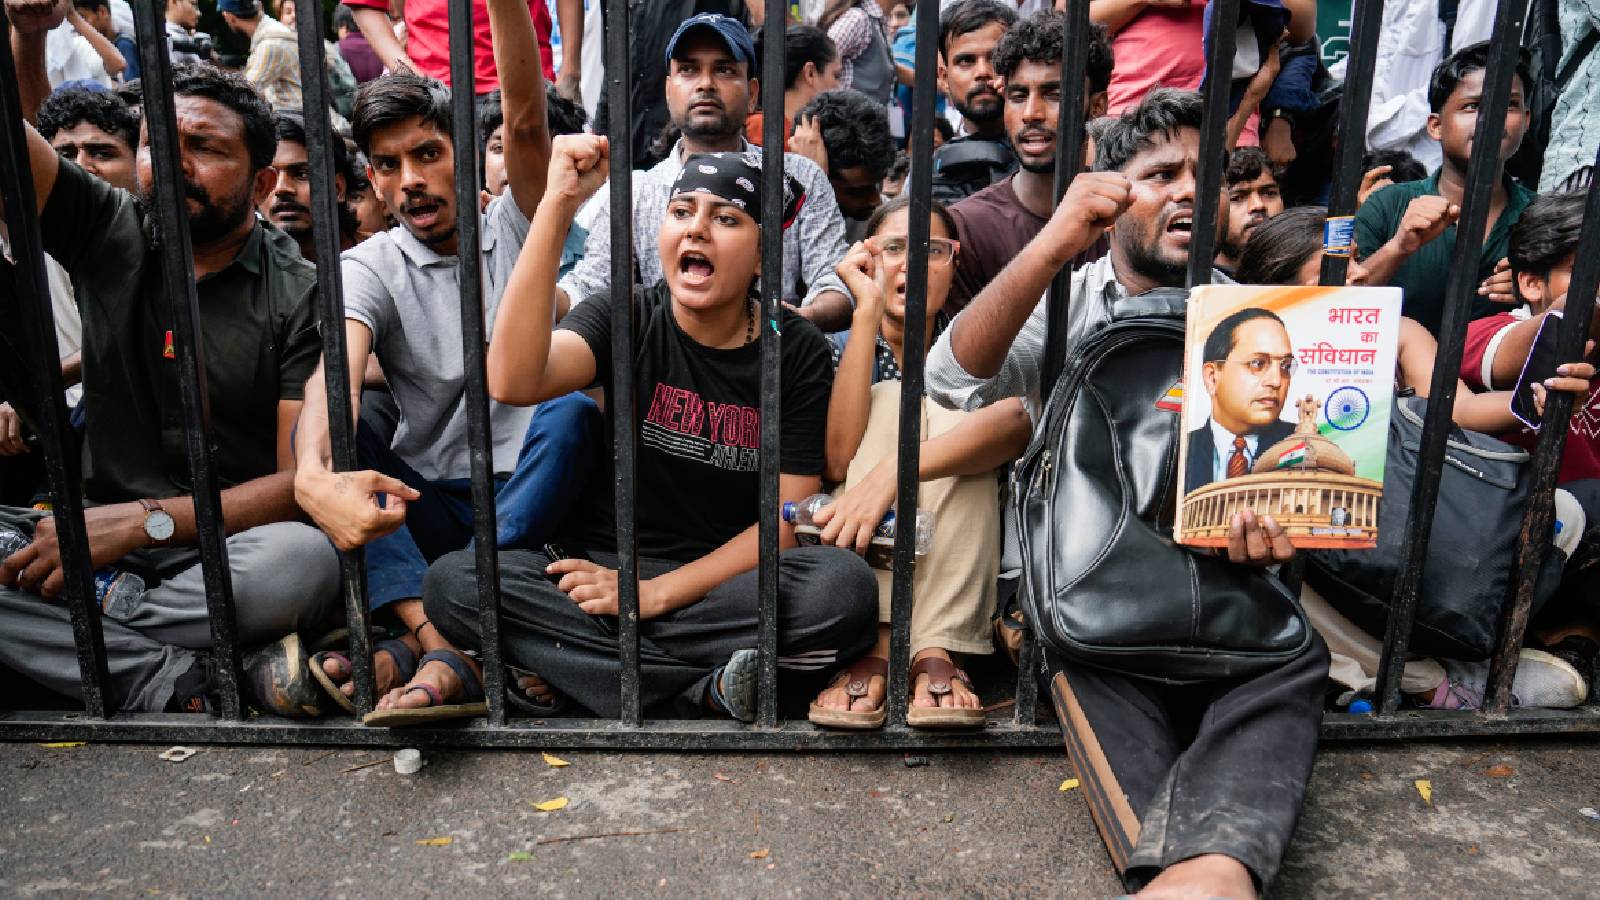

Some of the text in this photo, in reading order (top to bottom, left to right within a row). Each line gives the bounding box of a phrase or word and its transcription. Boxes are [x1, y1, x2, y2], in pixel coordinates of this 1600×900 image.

[1328, 308, 1382, 324] भारत
[1360, 331, 1379, 343] का
[1298, 341, 1377, 365] संविधान
[647, 382, 761, 449] NEW YOR
